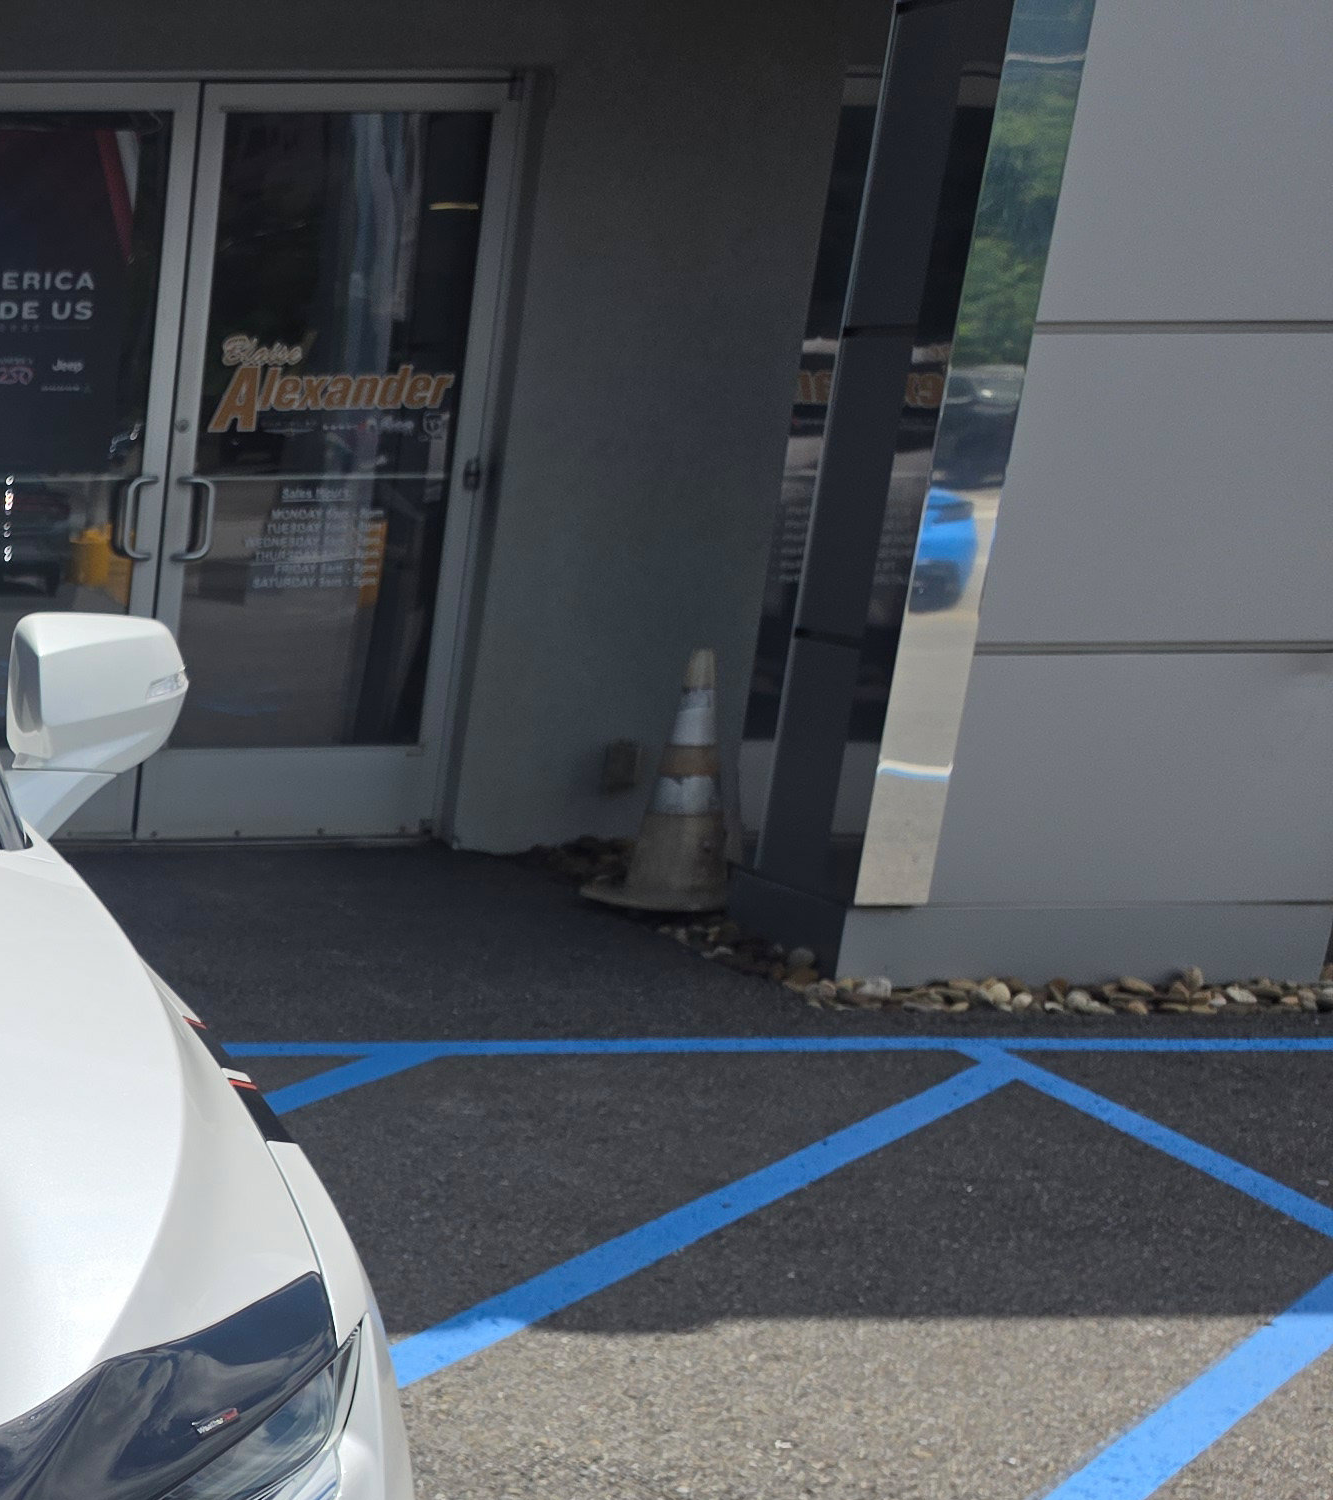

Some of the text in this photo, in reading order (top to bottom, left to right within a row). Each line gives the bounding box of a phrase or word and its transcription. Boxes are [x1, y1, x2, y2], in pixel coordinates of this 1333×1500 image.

[51, 301, 94, 321] US
[207, 364, 455, 433] Alexander
[270, 508, 323, 521] MONDAY
[266, 521, 322, 535] TUESDAY
[273, 563, 317, 575] FRIDAY
[251, 575, 316, 589] SATURDAY
